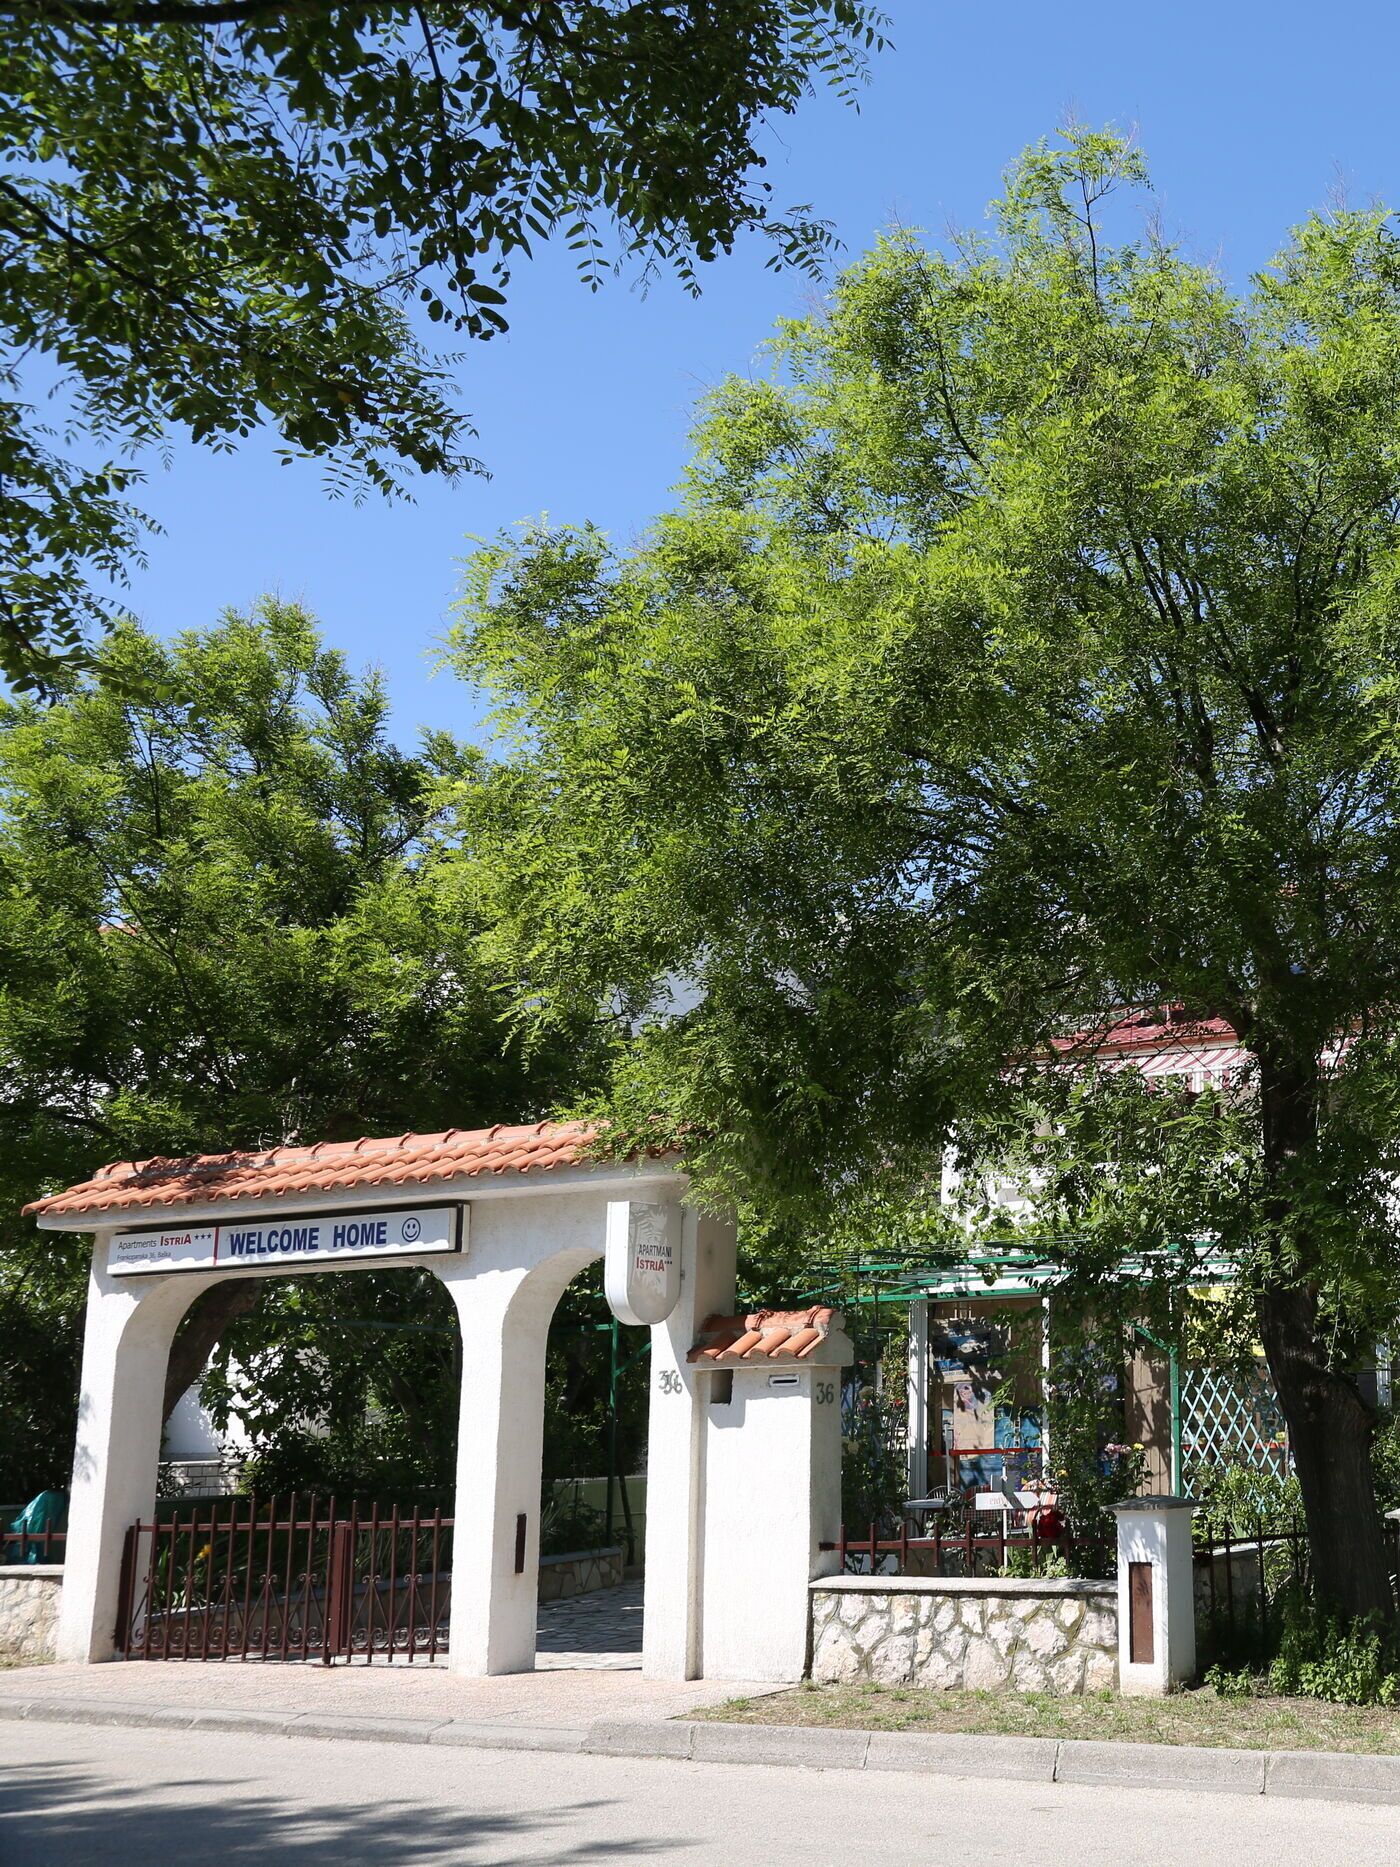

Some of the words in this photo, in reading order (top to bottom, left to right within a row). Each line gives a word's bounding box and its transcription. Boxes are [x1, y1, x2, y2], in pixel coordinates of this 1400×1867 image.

[118, 1239, 157, 1251] Apartments
[230, 1227, 319, 1256] WELCOME
[333, 1222, 387, 1248] HOME
[638, 1244, 673, 1257] APARTMANI
[658, 1370, 683, 1395] 36
[816, 1382, 834, 1404] 36
